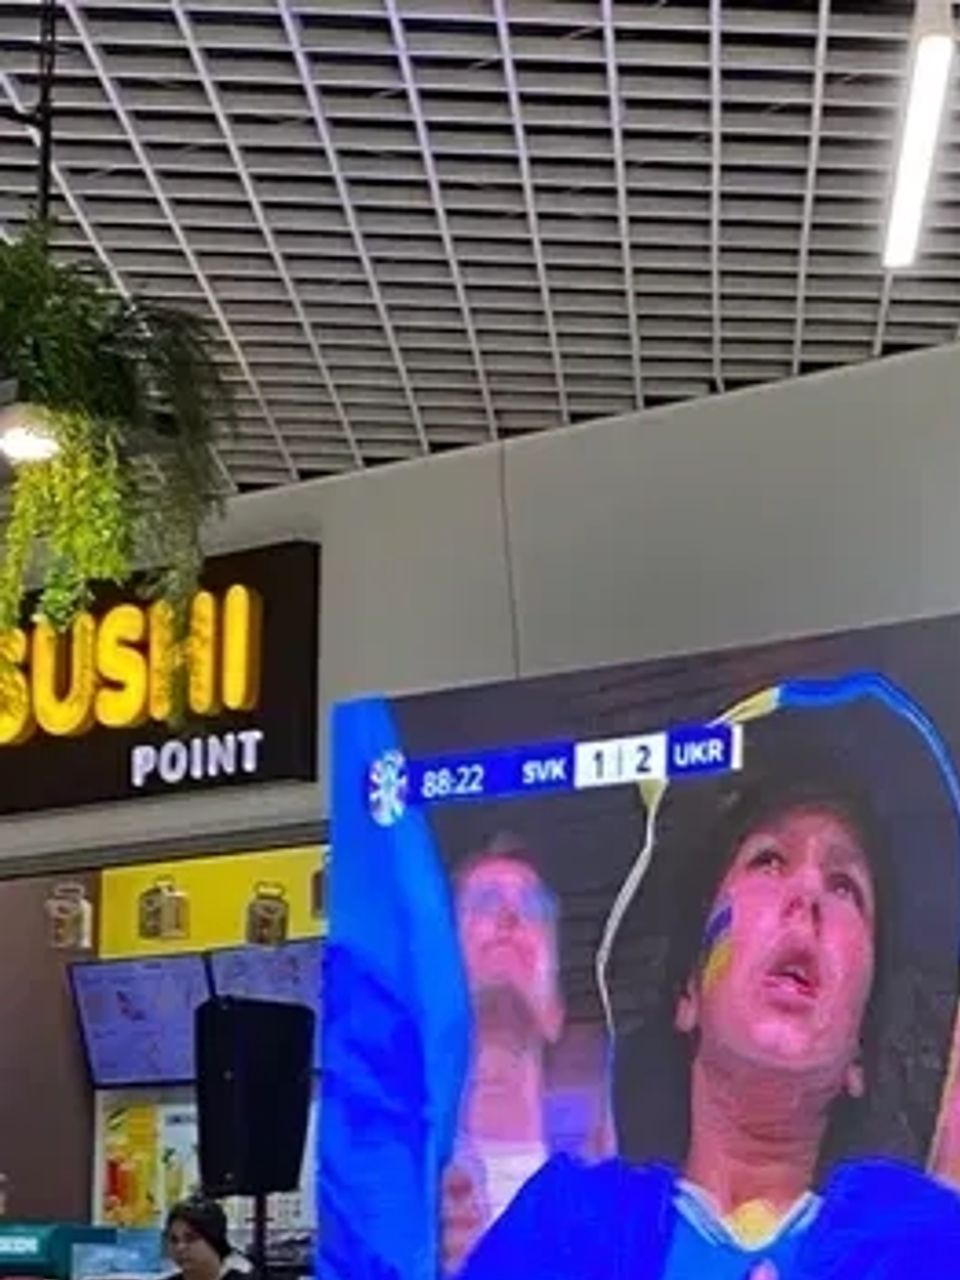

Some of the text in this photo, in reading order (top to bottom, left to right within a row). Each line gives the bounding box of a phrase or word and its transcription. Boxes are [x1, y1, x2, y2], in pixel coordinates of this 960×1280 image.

[130, 730, 264, 787] POINT
[421, 739, 725, 797] 88:22 SVK 1 2 UKR
